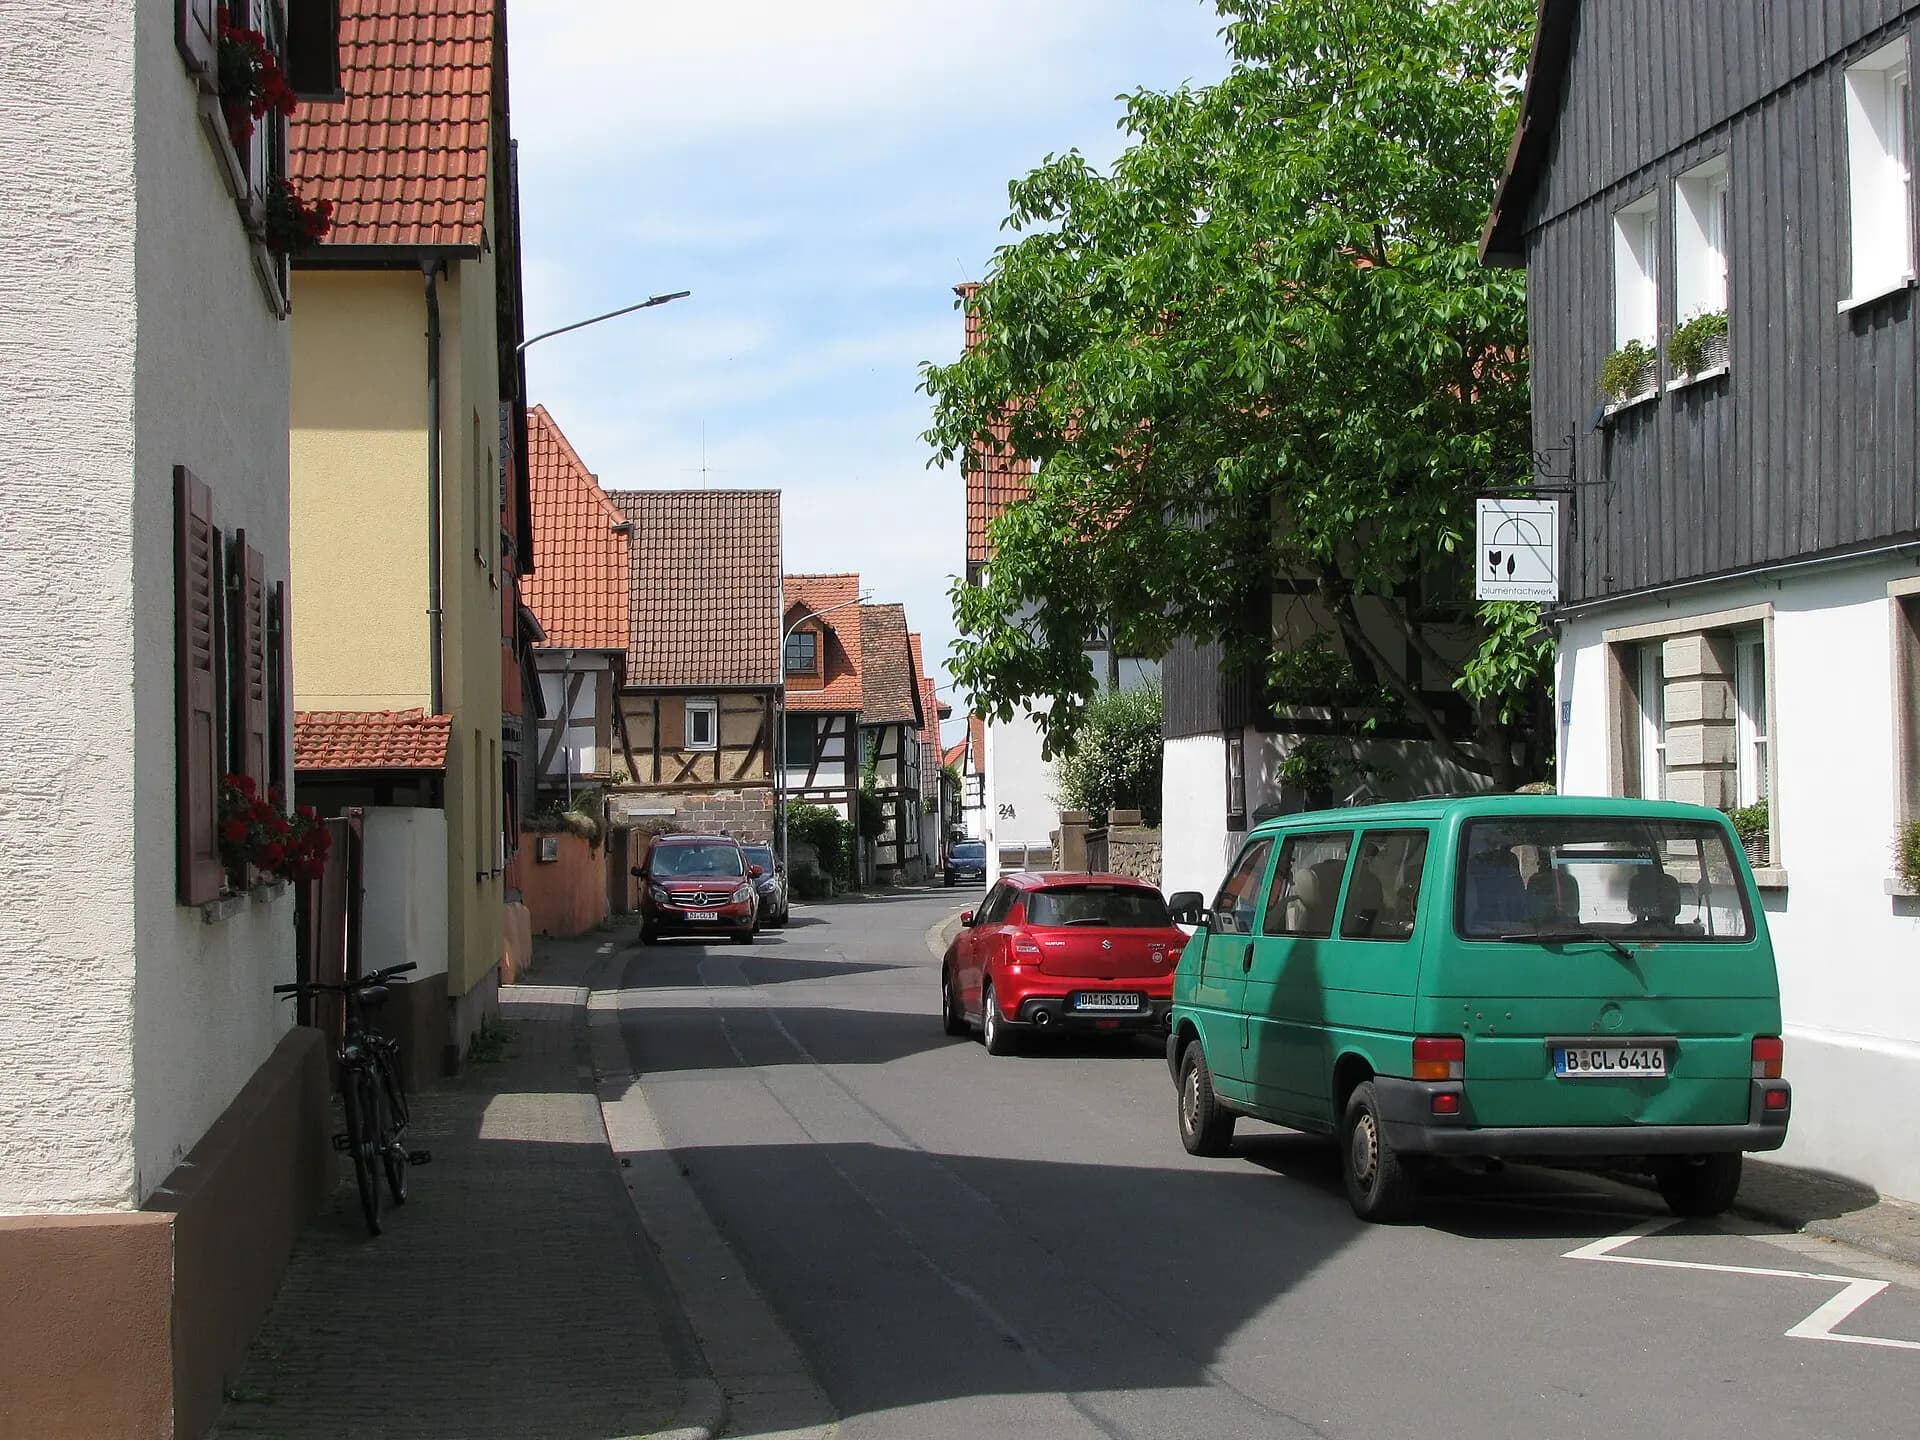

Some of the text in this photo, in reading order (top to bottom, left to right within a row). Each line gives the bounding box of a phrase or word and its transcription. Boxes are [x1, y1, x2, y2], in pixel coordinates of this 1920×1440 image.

[1481, 586, 1553, 596] blumenfachwerk
[998, 803, 1016, 817] 24
[1101, 994, 1113, 1005] MS
[1115, 993, 1138, 1005] 1610
[1567, 1050, 1662, 1070] B CL 6416
